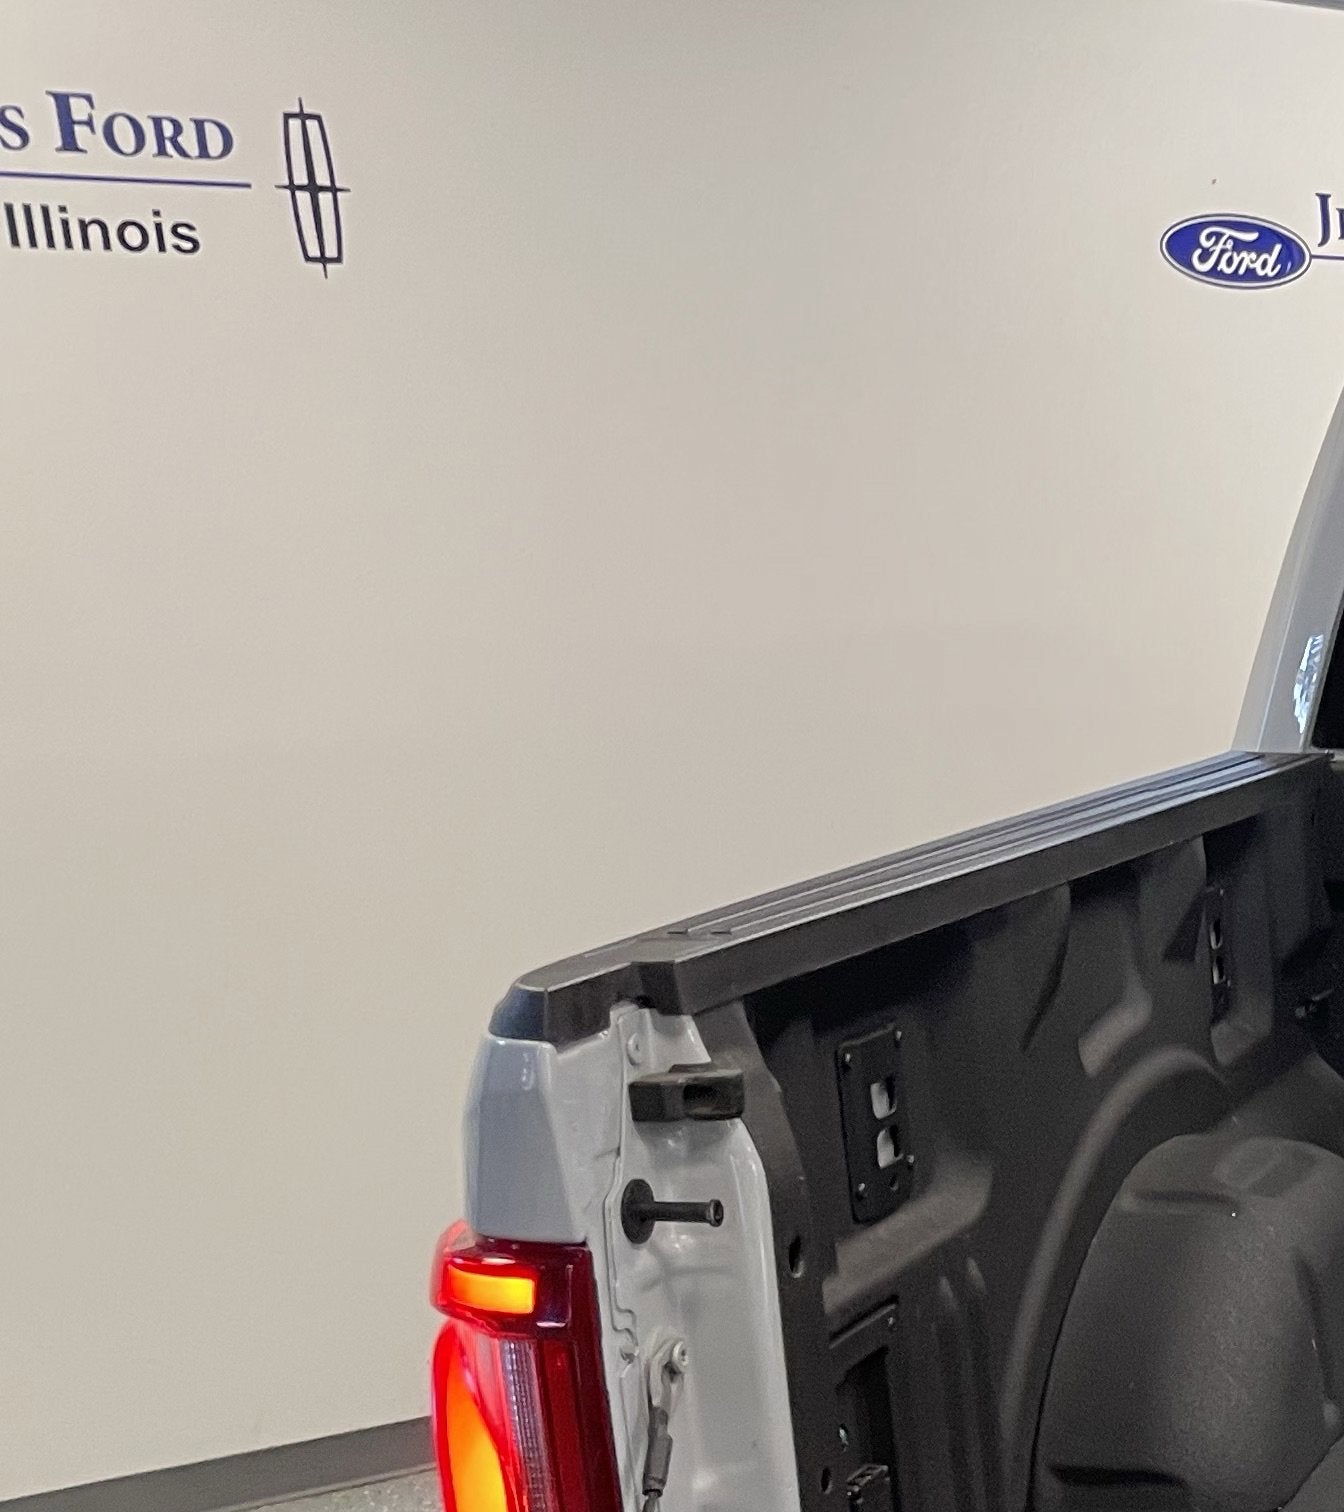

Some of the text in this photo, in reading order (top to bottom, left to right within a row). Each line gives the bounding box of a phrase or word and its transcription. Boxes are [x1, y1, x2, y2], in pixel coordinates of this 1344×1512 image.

[46, 89, 234, 160] FORD
[4, 202, 201, 255] Illinois
[1191, 226, 1283, 278] Ford
